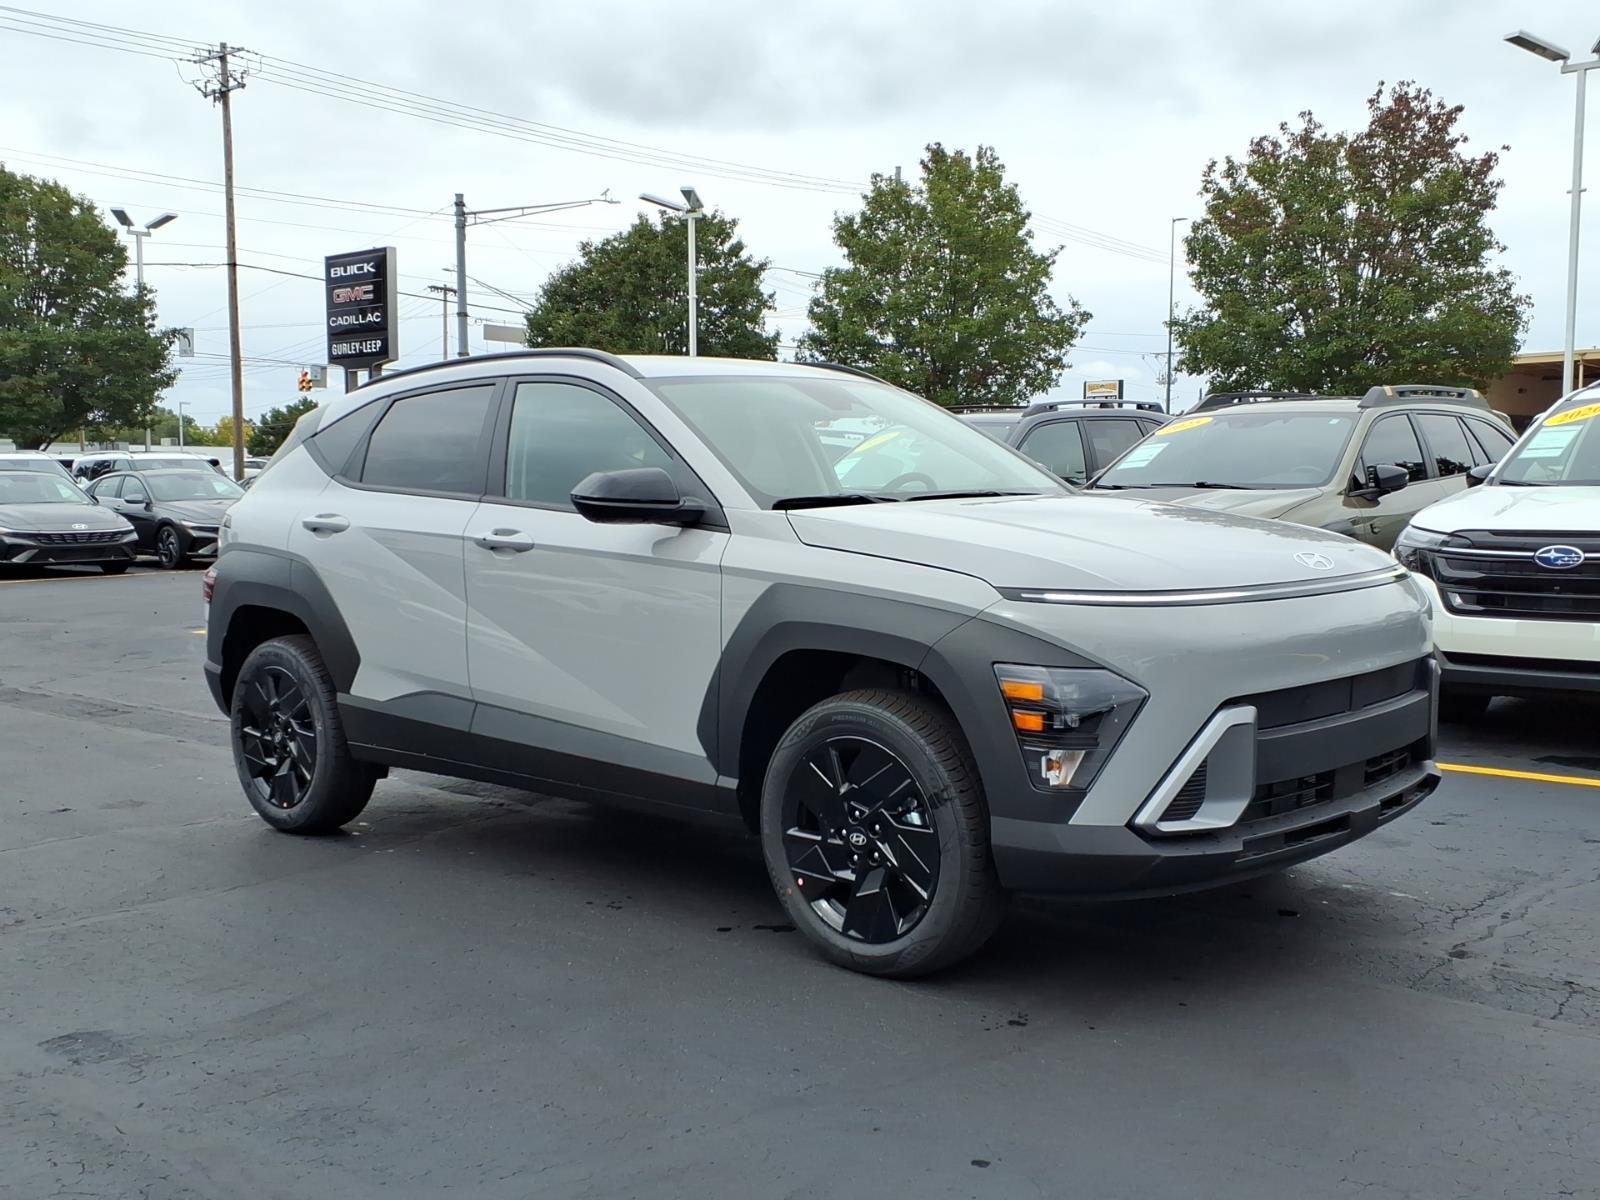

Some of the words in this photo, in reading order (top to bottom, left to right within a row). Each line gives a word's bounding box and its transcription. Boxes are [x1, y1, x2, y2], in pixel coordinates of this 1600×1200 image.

[330, 262, 376, 278] BUICK
[332, 285, 374, 303] GMC
[329, 312, 381, 327] CADILLAC
[331, 340, 382, 355] GURLEY-LEEP
